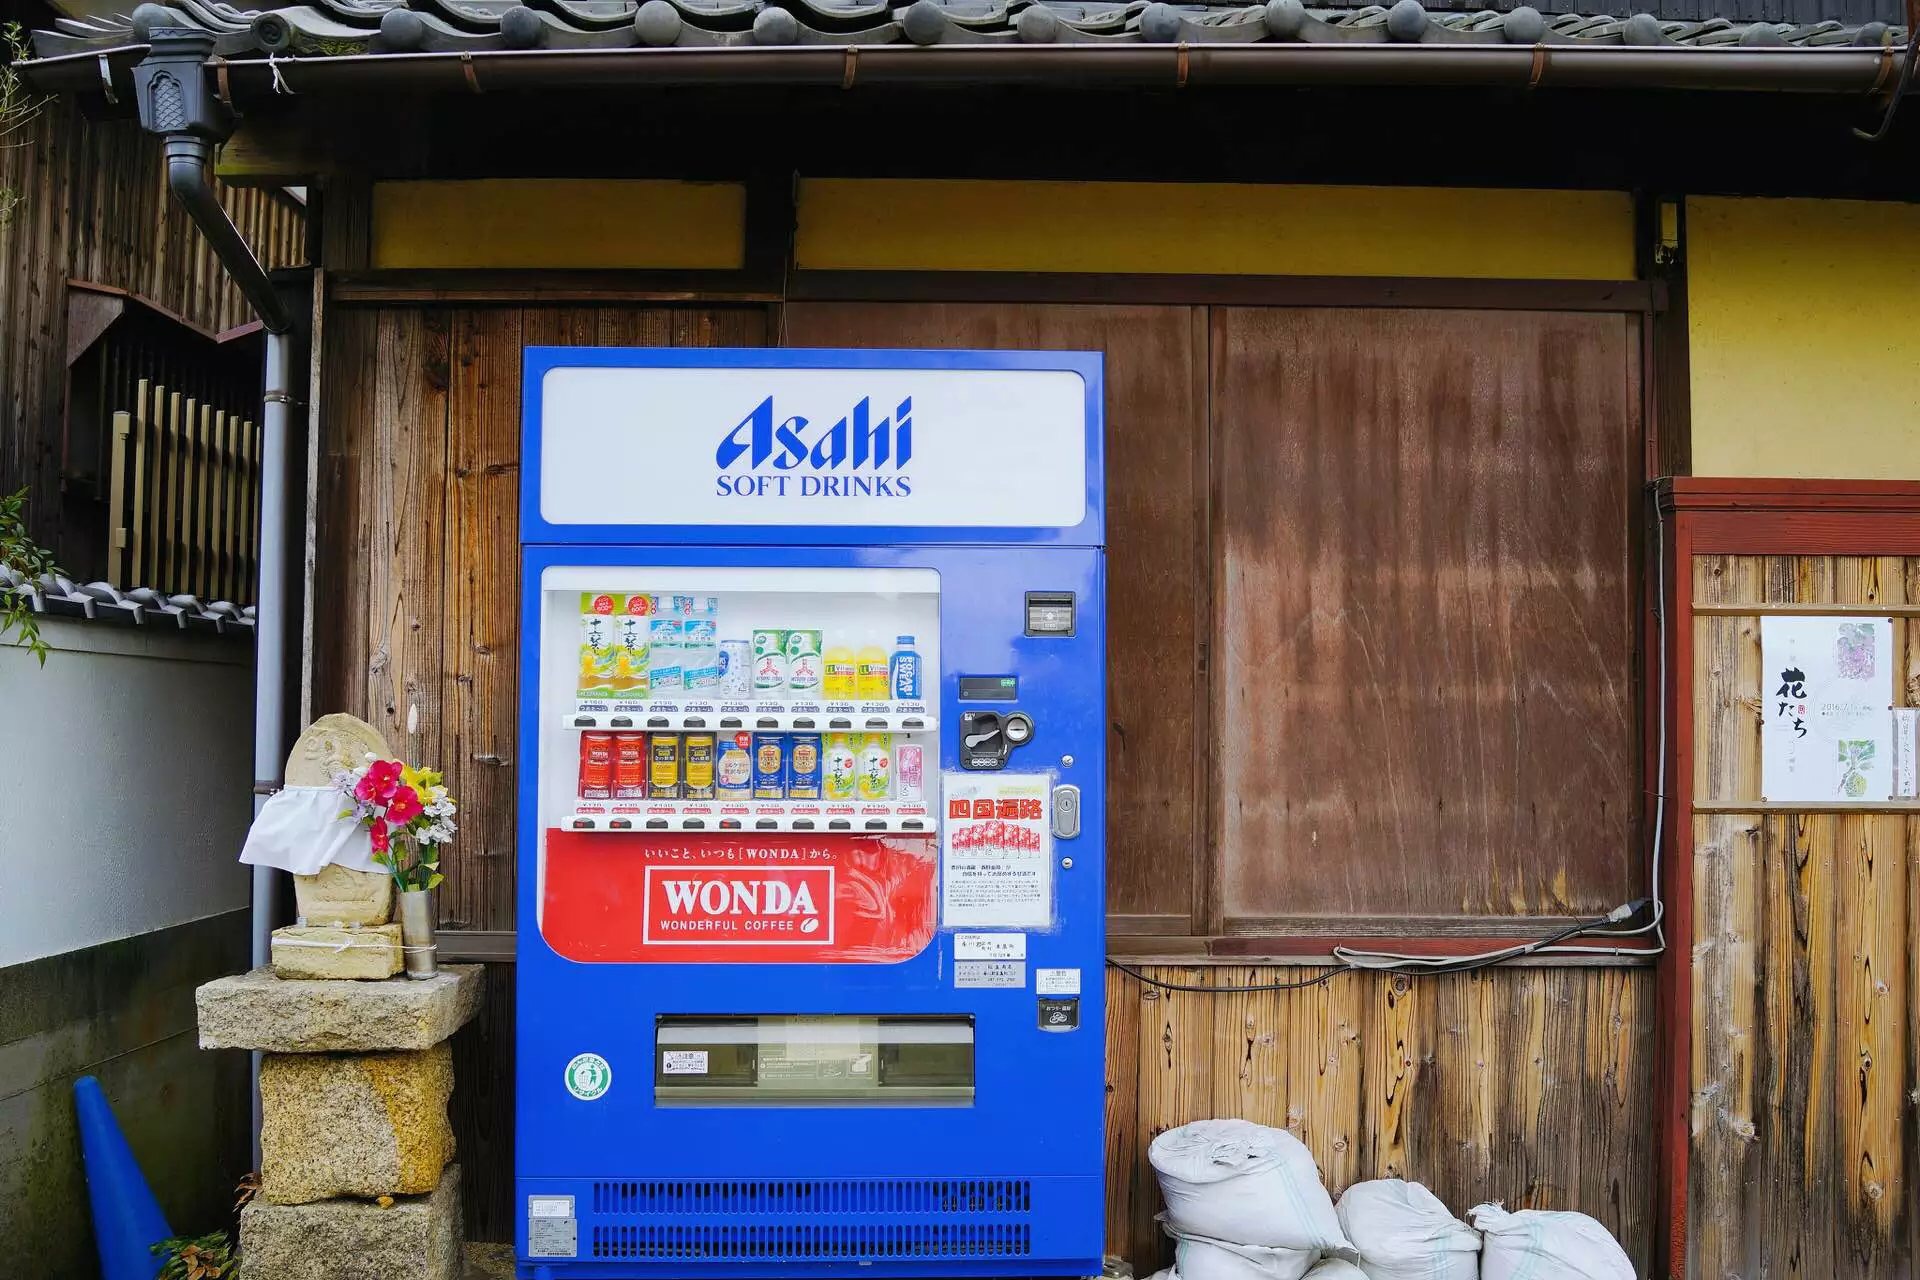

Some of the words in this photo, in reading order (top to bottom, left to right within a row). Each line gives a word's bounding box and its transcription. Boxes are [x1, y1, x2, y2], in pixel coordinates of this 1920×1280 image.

[716, 395, 911, 470] Asahi
[716, 475, 791, 497] SOFT
[801, 475, 911, 497] DRINKS
[899, 656, 907, 692] SWEAT
[906, 656, 914, 696] POCARI
[1775, 667, 1808, 739] 花たち
[949, 799, 1042, 820] 四国遍路
[662, 880, 818, 915] WONDA
[660, 920, 738, 931] WONDERFUL
[744, 920, 794, 931] COFFEE
